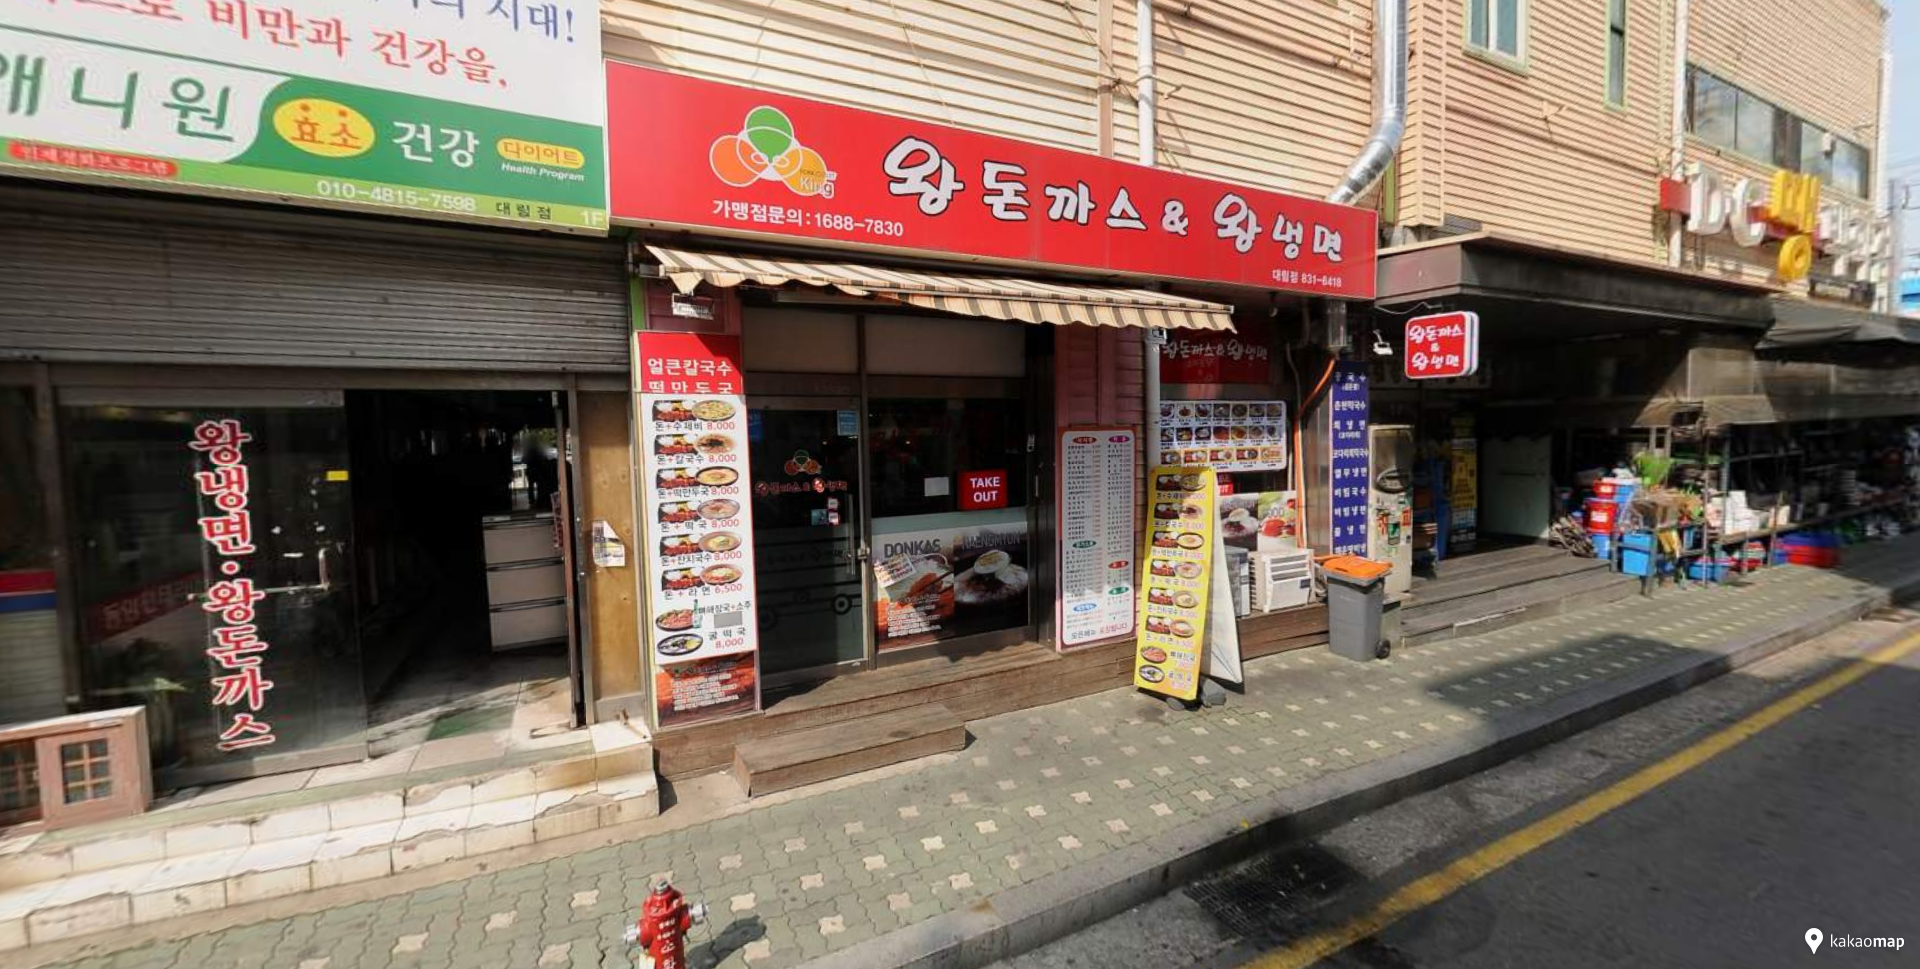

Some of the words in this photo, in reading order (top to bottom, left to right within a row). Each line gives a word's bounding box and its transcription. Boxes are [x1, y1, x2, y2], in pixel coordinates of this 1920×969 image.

[207, 0, 352, 58] 비만과
[291, 102, 363, 150] 효소
[392, 120, 481, 169] 건강
[502, 140, 581, 166] 다이어트
[501, 162, 538, 176] Health
[538, 167, 585, 182] Program
[799, 176, 835, 199] King
[316, 179, 477, 212] 010-4815-7598
[580, 210, 606, 227] 1F
[1160, 198, 1189, 236] &
[1300, 271, 1342, 287] 831-6418
[1409, 324, 1465, 343] 왕돈까스
[647, 358, 733, 377] 얼큰칼국수
[1411, 352, 1460, 371] 왕냉면
[969, 476, 1001, 489] TAKE
[973, 490, 999, 503] OUT
[714, 551, 742, 562] 8,000
[884, 538, 943, 559] DONKAS
